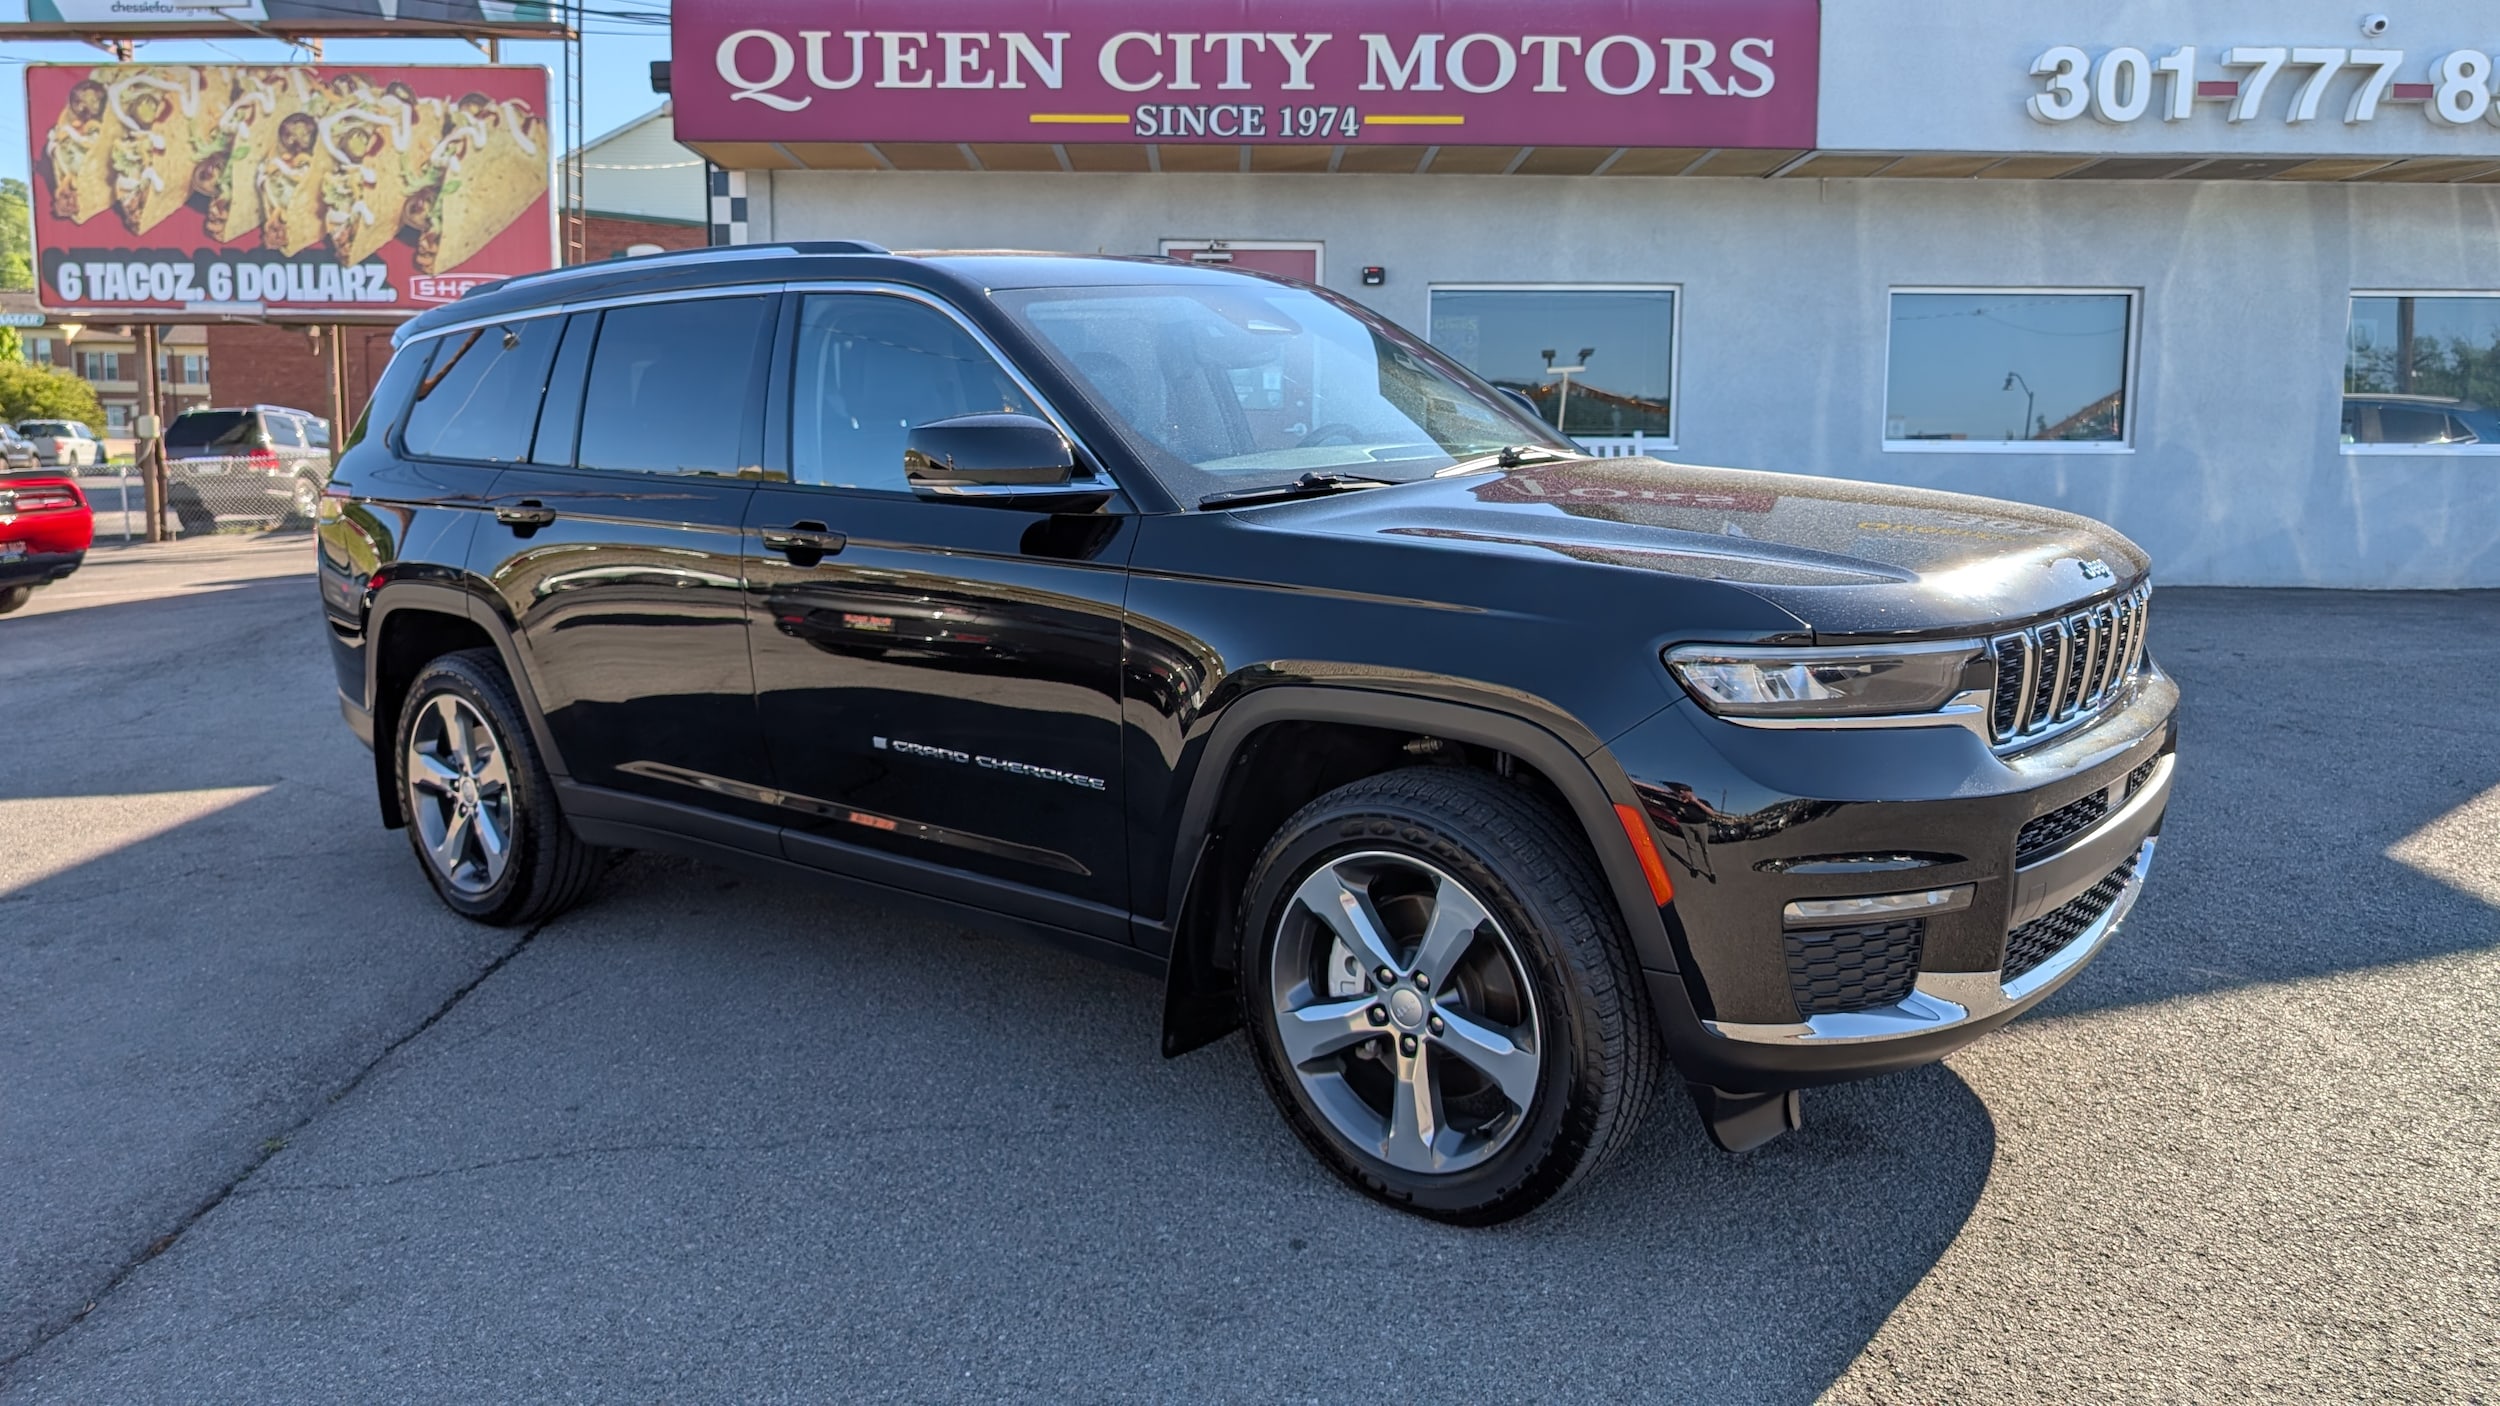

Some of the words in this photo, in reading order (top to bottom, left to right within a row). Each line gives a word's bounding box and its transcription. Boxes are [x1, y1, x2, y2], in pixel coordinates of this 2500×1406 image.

[715, 30, 1071, 112] QUEEN
[1098, 32, 1332, 92] CITY
[1358, 33, 1776, 98] MOTORS
[2025, 45, 2500, 129] 301-777-8
[1134, 105, 1266, 138] SINCE
[1278, 105, 1360, 138] 1974
[57, 262, 82, 301] 6
[85, 262, 206, 301] TACOZ.
[208, 262, 233, 301] 6
[236, 263, 398, 303] DOLLARZ.
[2078, 557, 2110, 580] Jeep
[892, 740, 969, 763] GRAND
[975, 755, 1106, 791] CHEROKEE
